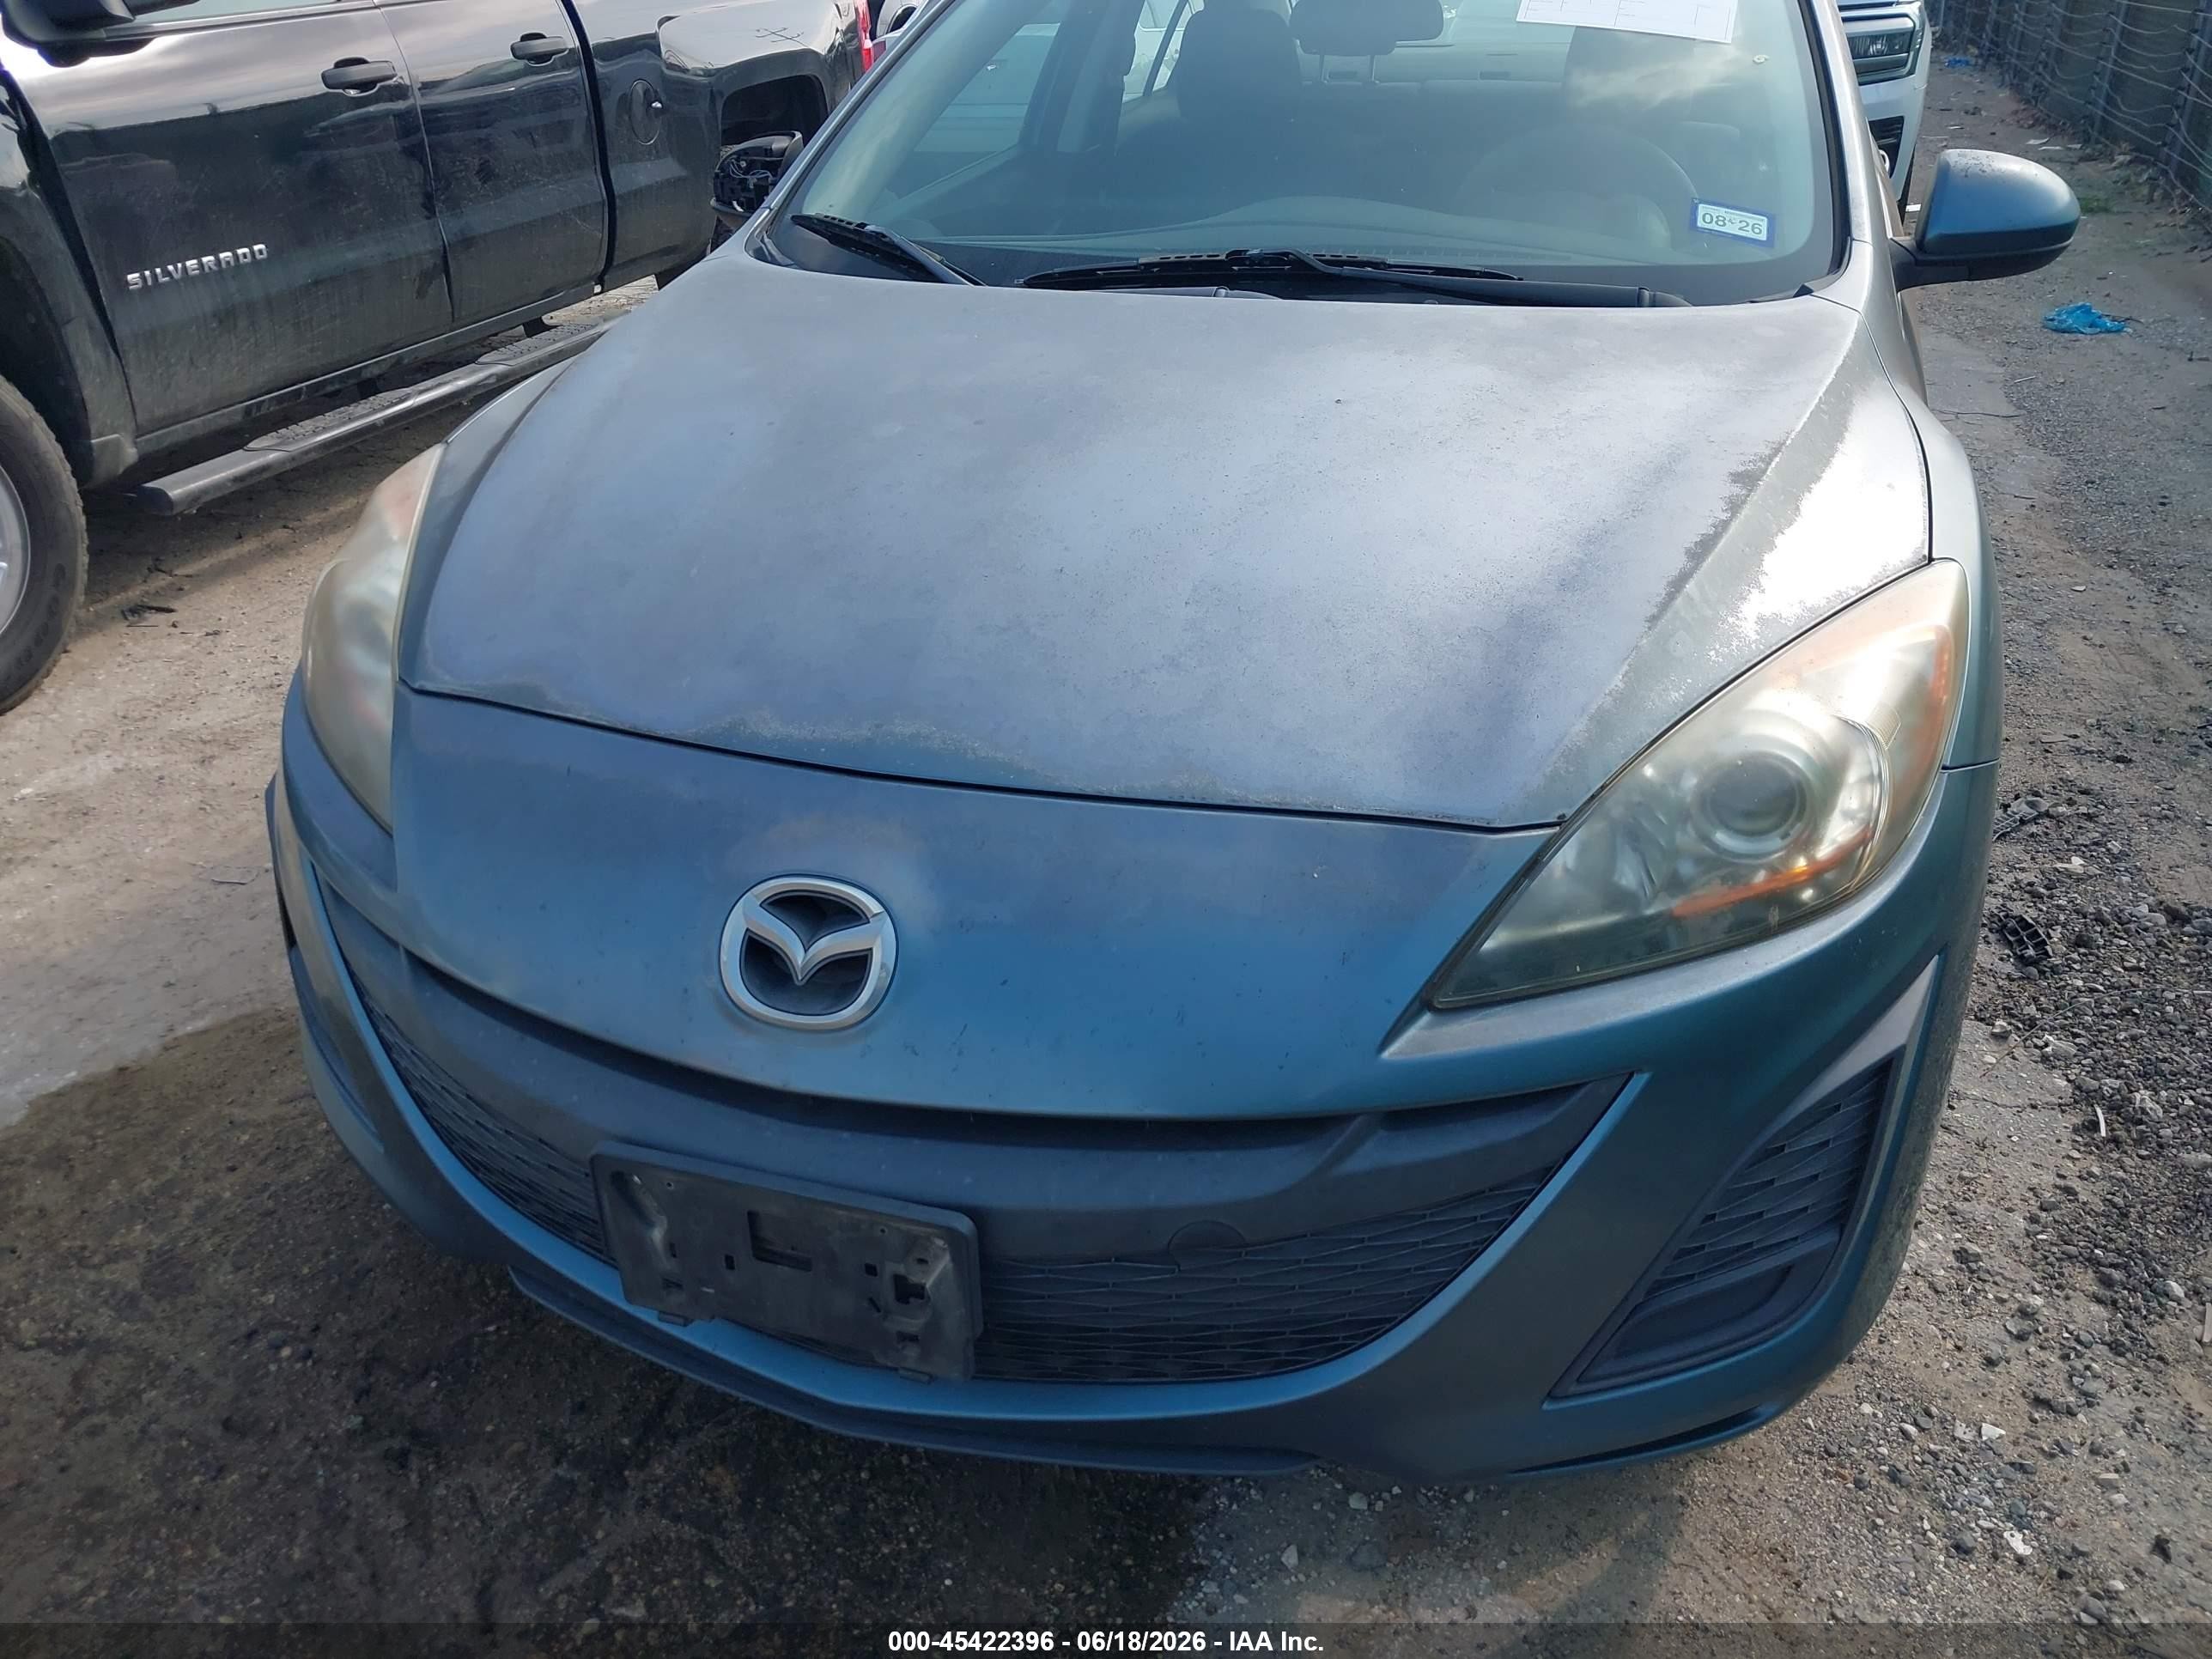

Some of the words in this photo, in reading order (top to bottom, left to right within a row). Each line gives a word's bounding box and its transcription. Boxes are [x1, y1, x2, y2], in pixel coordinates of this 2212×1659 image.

[1702, 212, 1727, 228] 08
[1737, 220, 1763, 235] 26
[126, 243, 268, 290] SILVERADO
